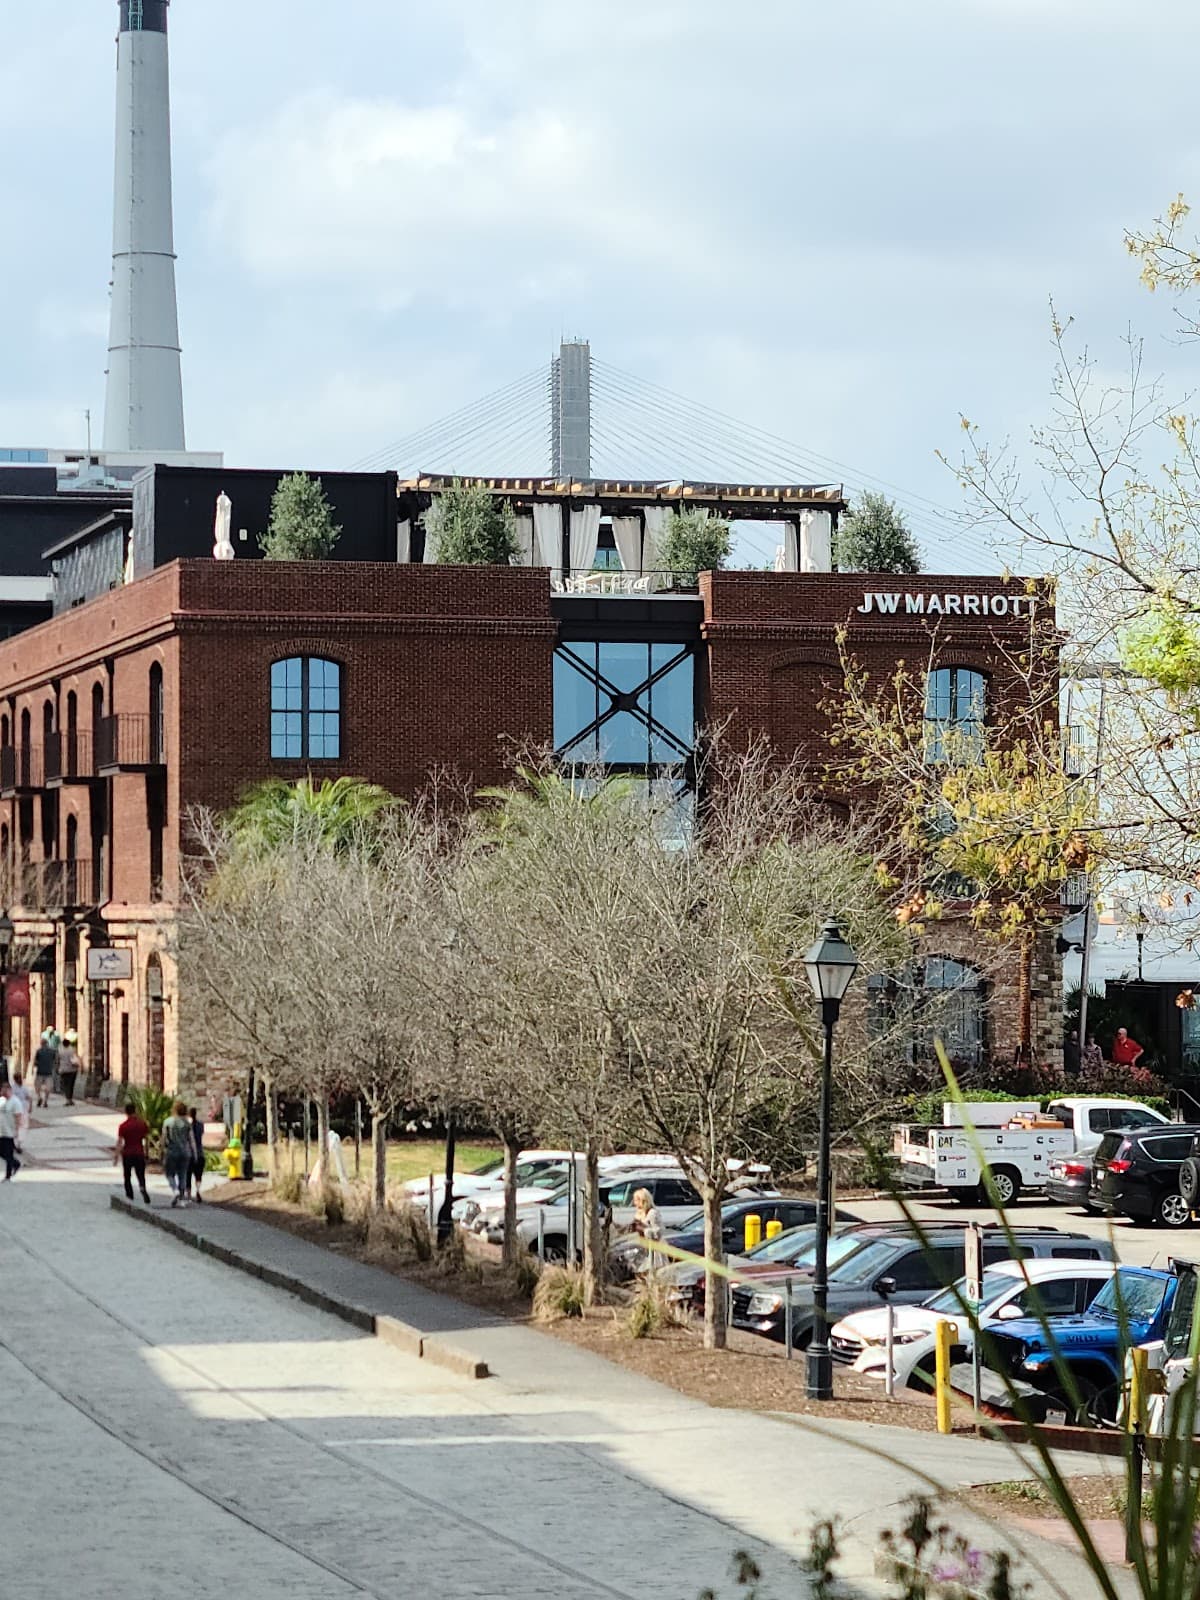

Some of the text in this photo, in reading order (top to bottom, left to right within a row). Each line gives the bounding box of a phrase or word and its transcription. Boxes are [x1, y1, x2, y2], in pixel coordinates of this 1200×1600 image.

[857, 593, 1039, 616] JW MARRIOTT
[938, 1136, 954, 1148] CAT
